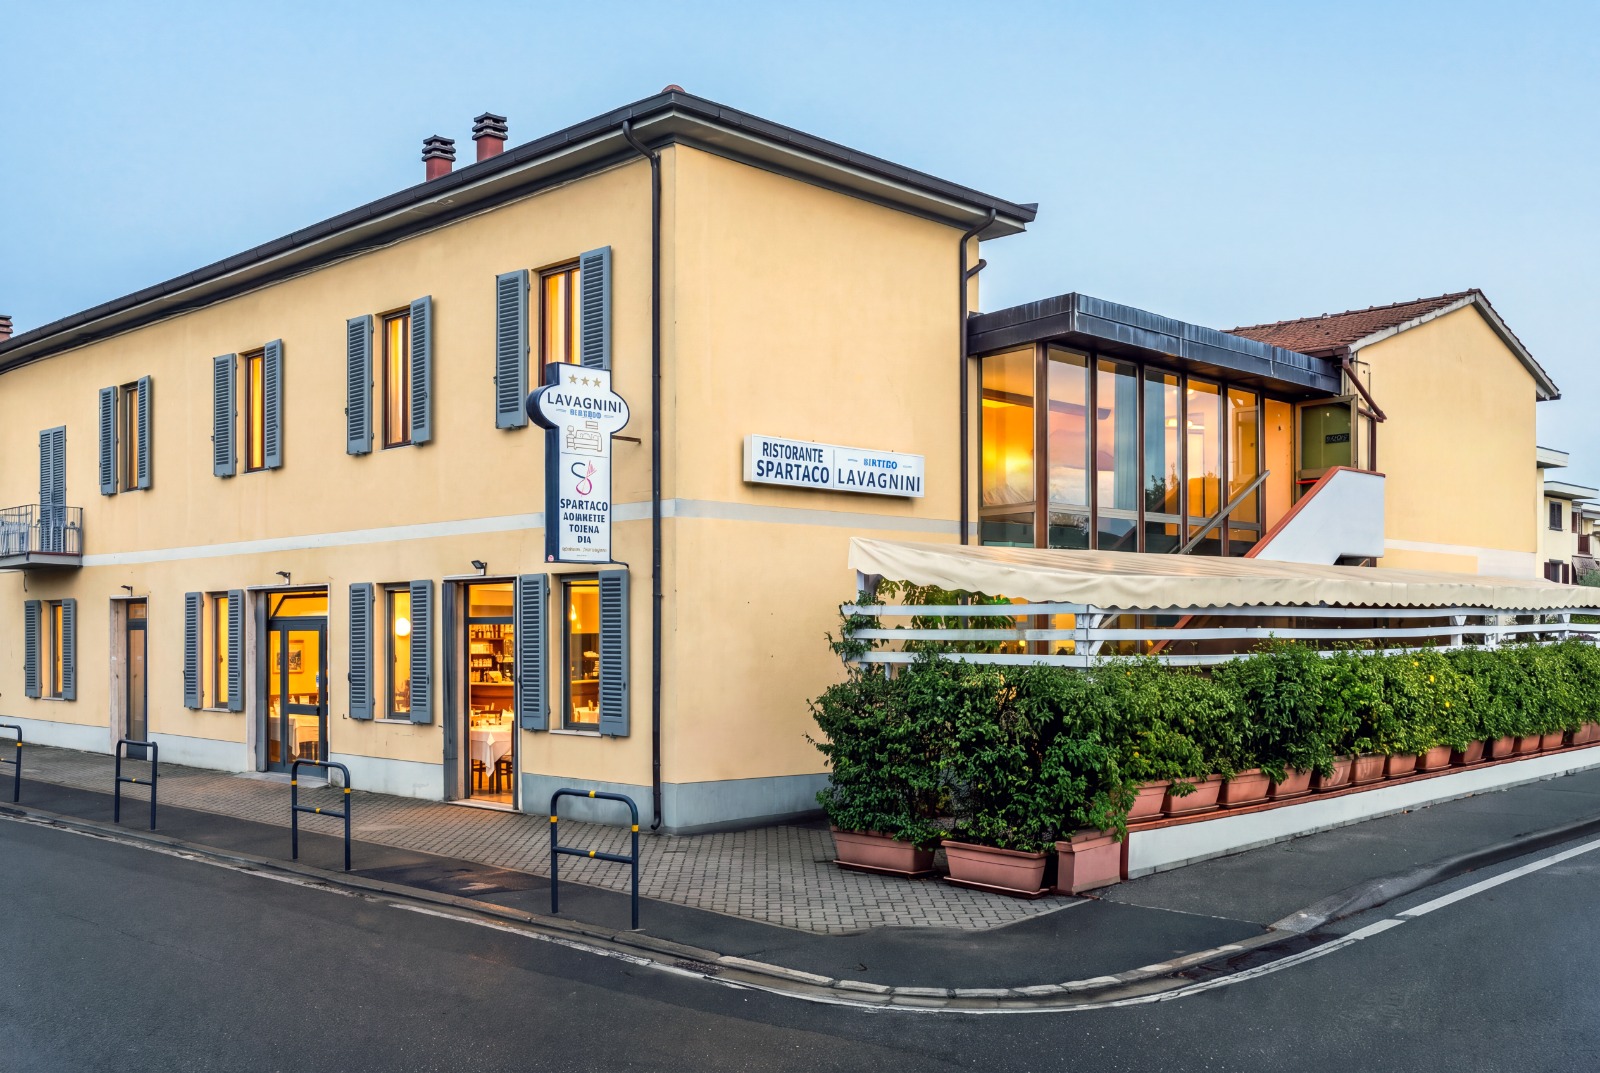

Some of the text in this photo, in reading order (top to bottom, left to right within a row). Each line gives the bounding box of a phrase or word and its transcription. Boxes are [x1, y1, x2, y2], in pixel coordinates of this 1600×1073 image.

[547, 392, 622, 413] LAVAGNINI
[762, 441, 824, 463] RISTORANTE
[756, 459, 830, 484] SPARTACO
[838, 468, 921, 492] LAVAGNINI
[560, 498, 609, 511] SPARTACO
